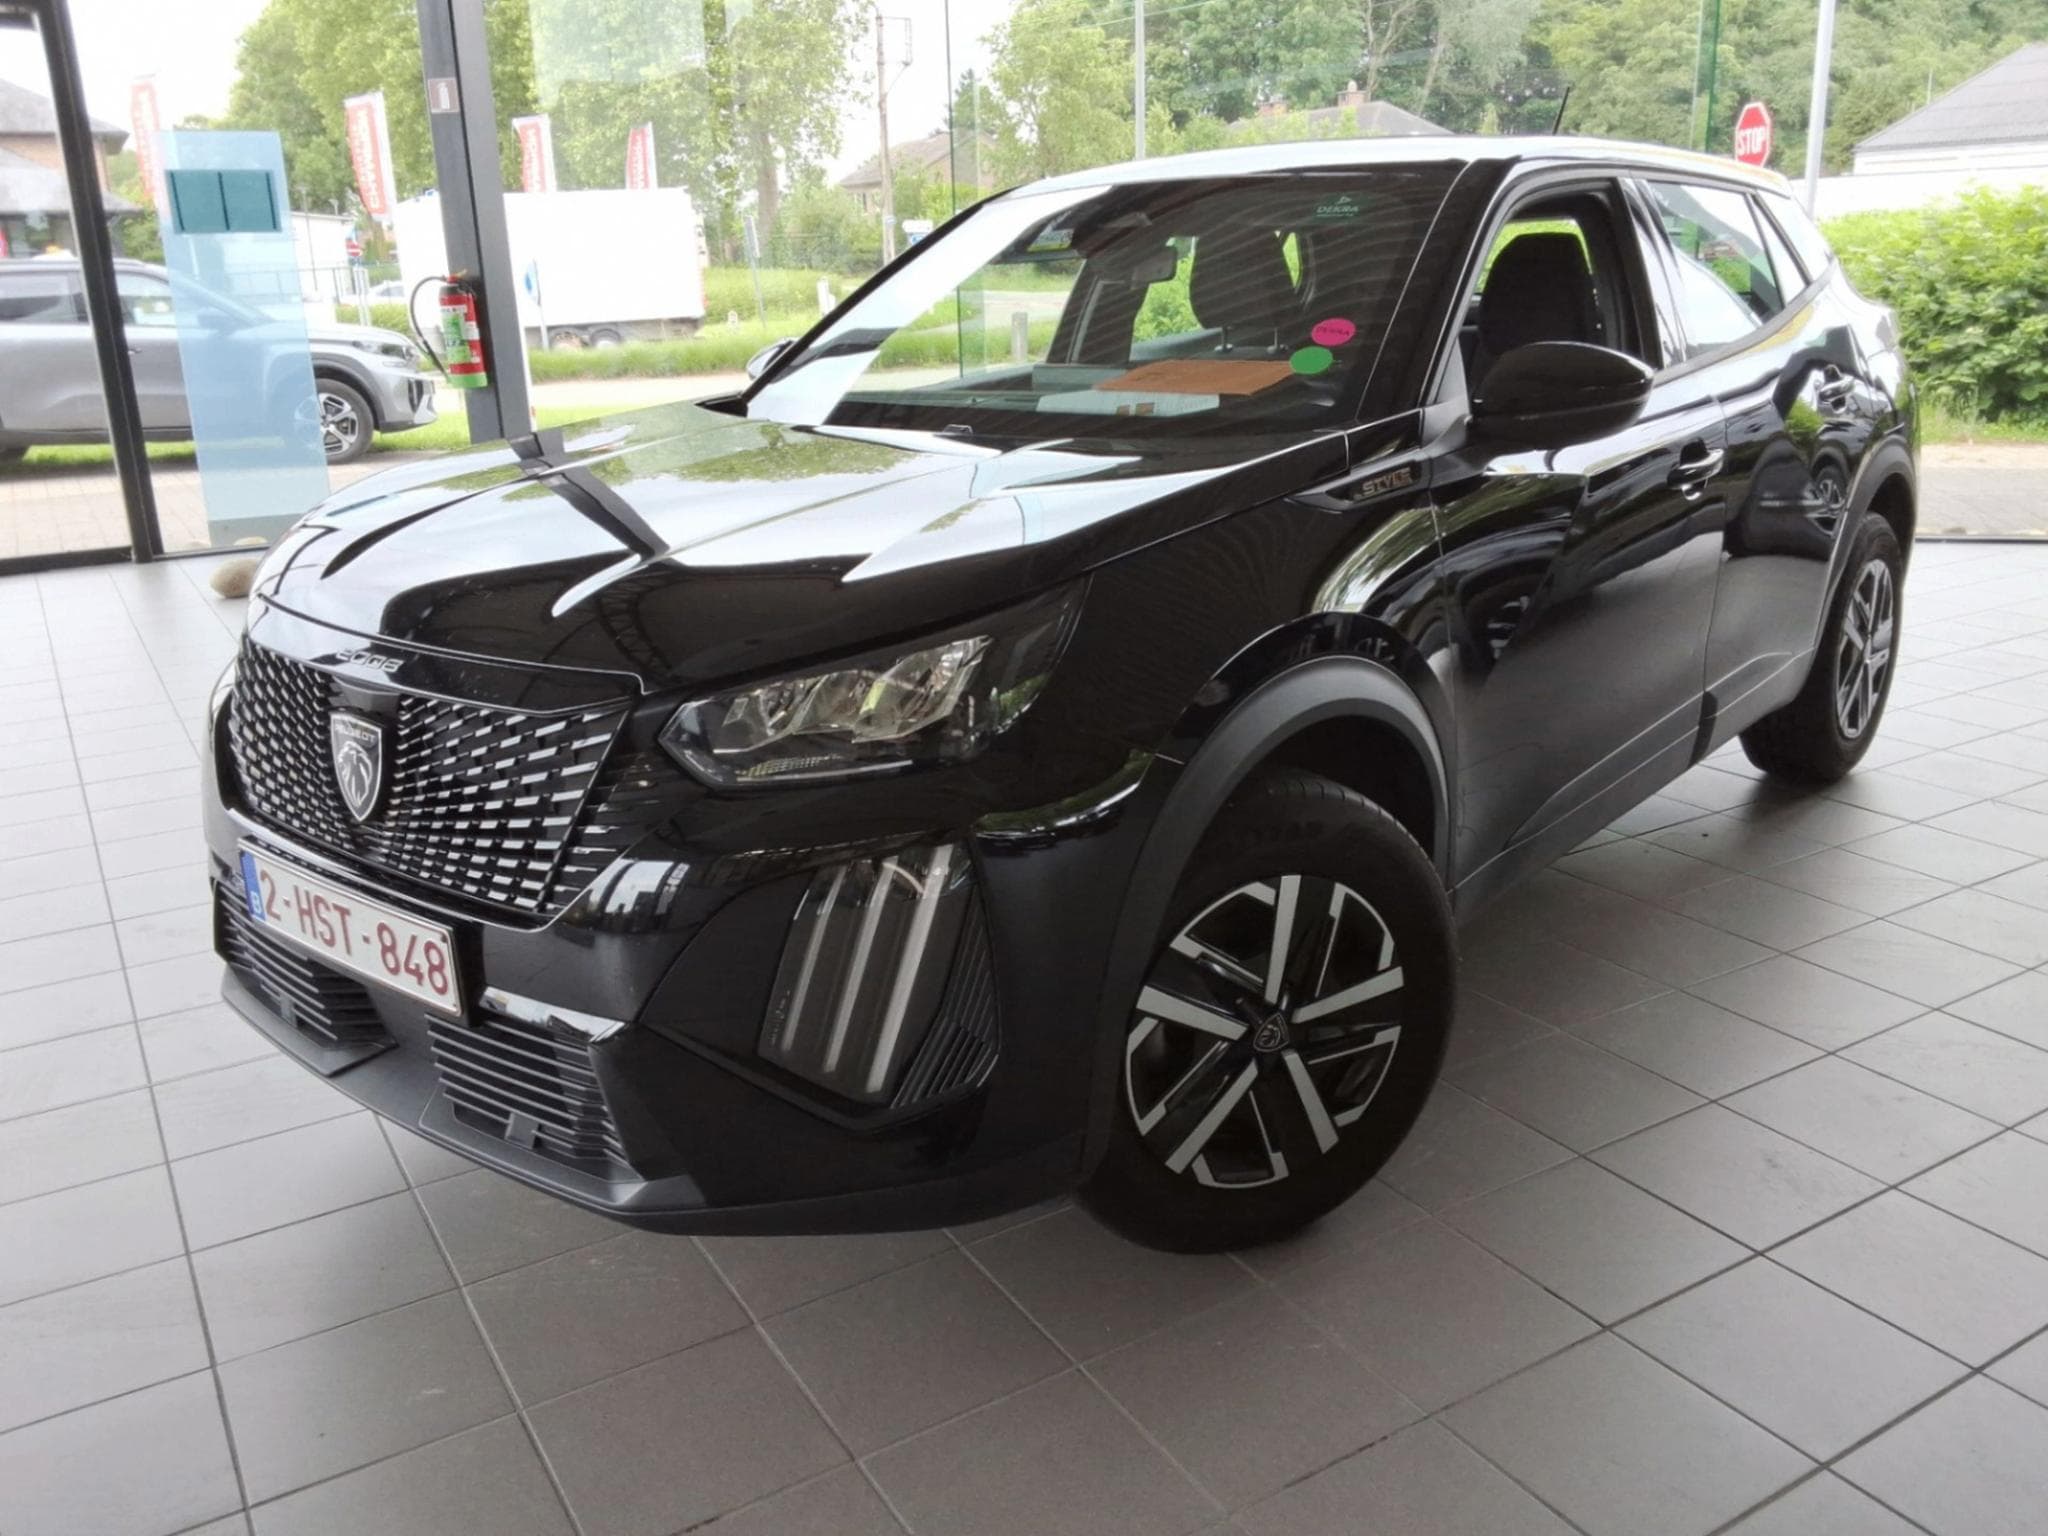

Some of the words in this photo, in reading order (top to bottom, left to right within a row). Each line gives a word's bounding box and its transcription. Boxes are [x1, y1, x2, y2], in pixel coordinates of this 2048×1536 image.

[1738, 127, 1766, 156] STOP
[1363, 467, 1411, 496] STYLE
[259, 869, 449, 996] 2-HST-848
